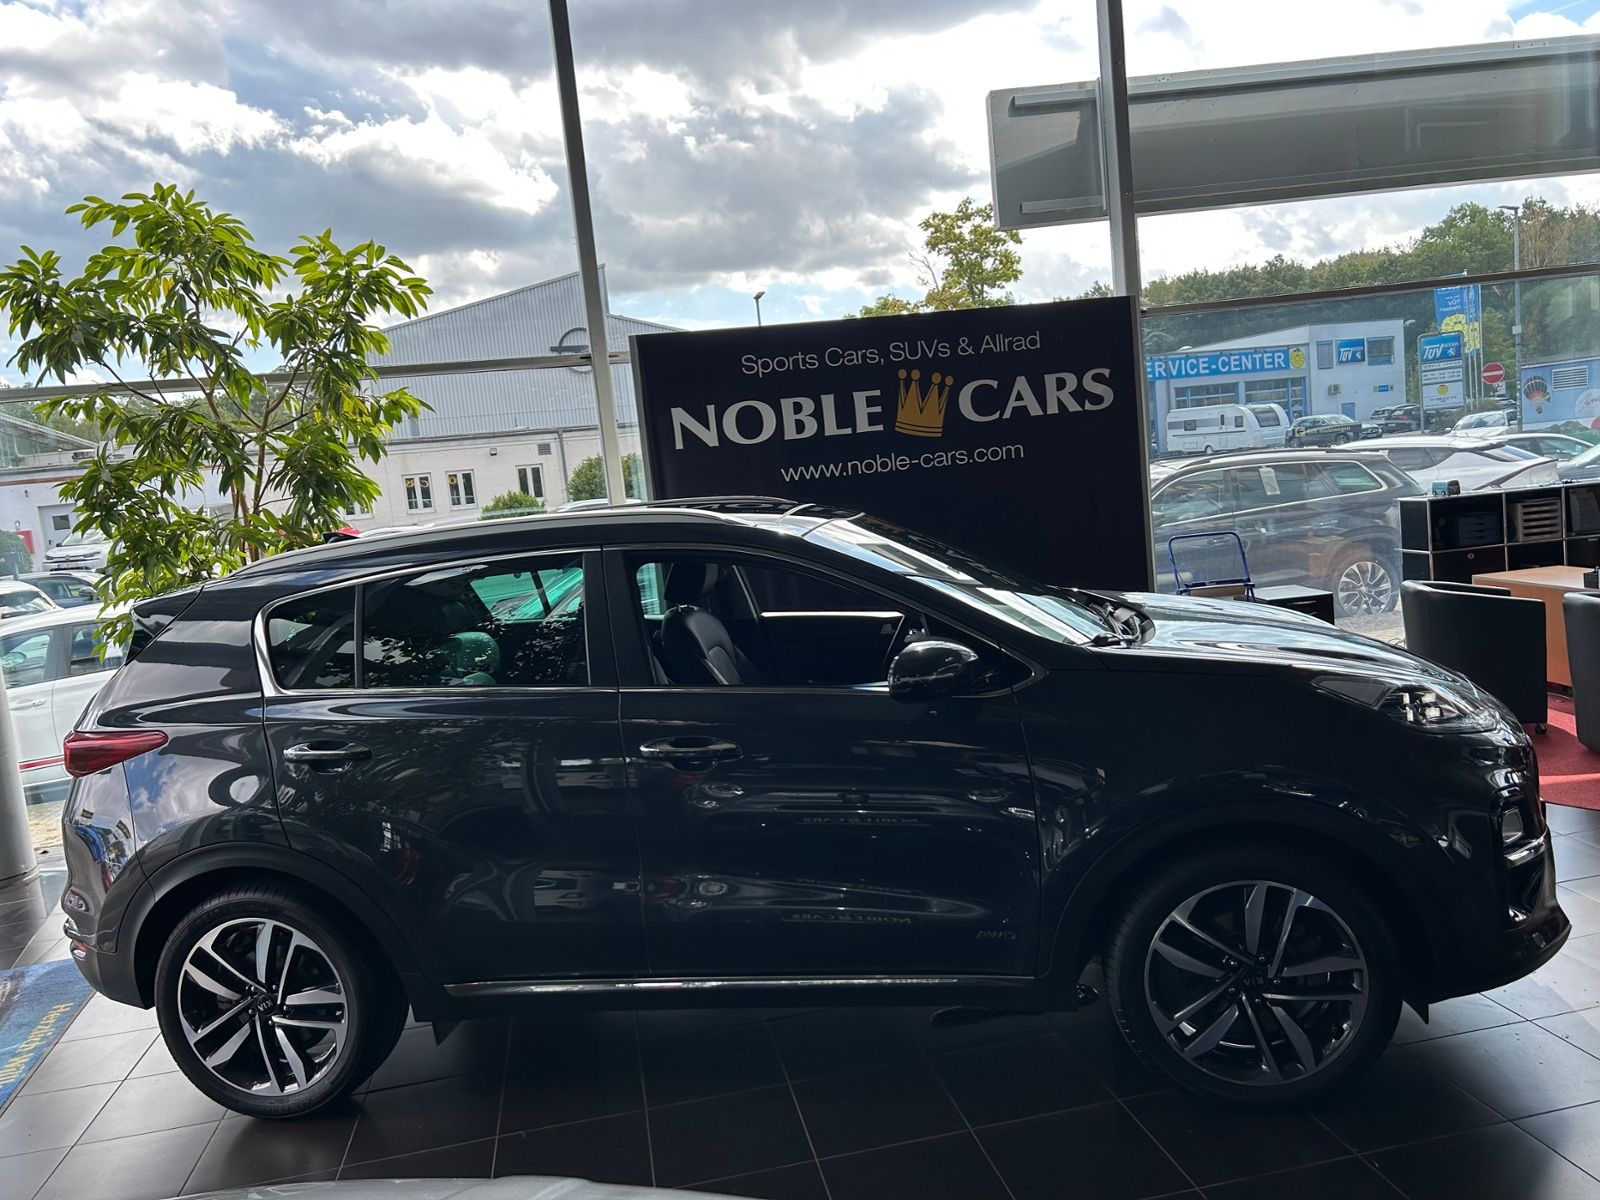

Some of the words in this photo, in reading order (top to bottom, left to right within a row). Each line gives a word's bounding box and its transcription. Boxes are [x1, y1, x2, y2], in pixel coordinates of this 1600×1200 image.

[741, 355, 819, 377] Sports
[825, 347, 885, 366] Cars,
[889, 338, 950, 361] SUVs
[957, 337, 975, 355] &
[980, 331, 1040, 354] Allrad
[670, 389, 884, 450] NOBLE
[958, 368, 1115, 422] CARS
[781, 443, 1024, 482] www.noble-cars.com
[975, 930, 1017, 940] AWD
